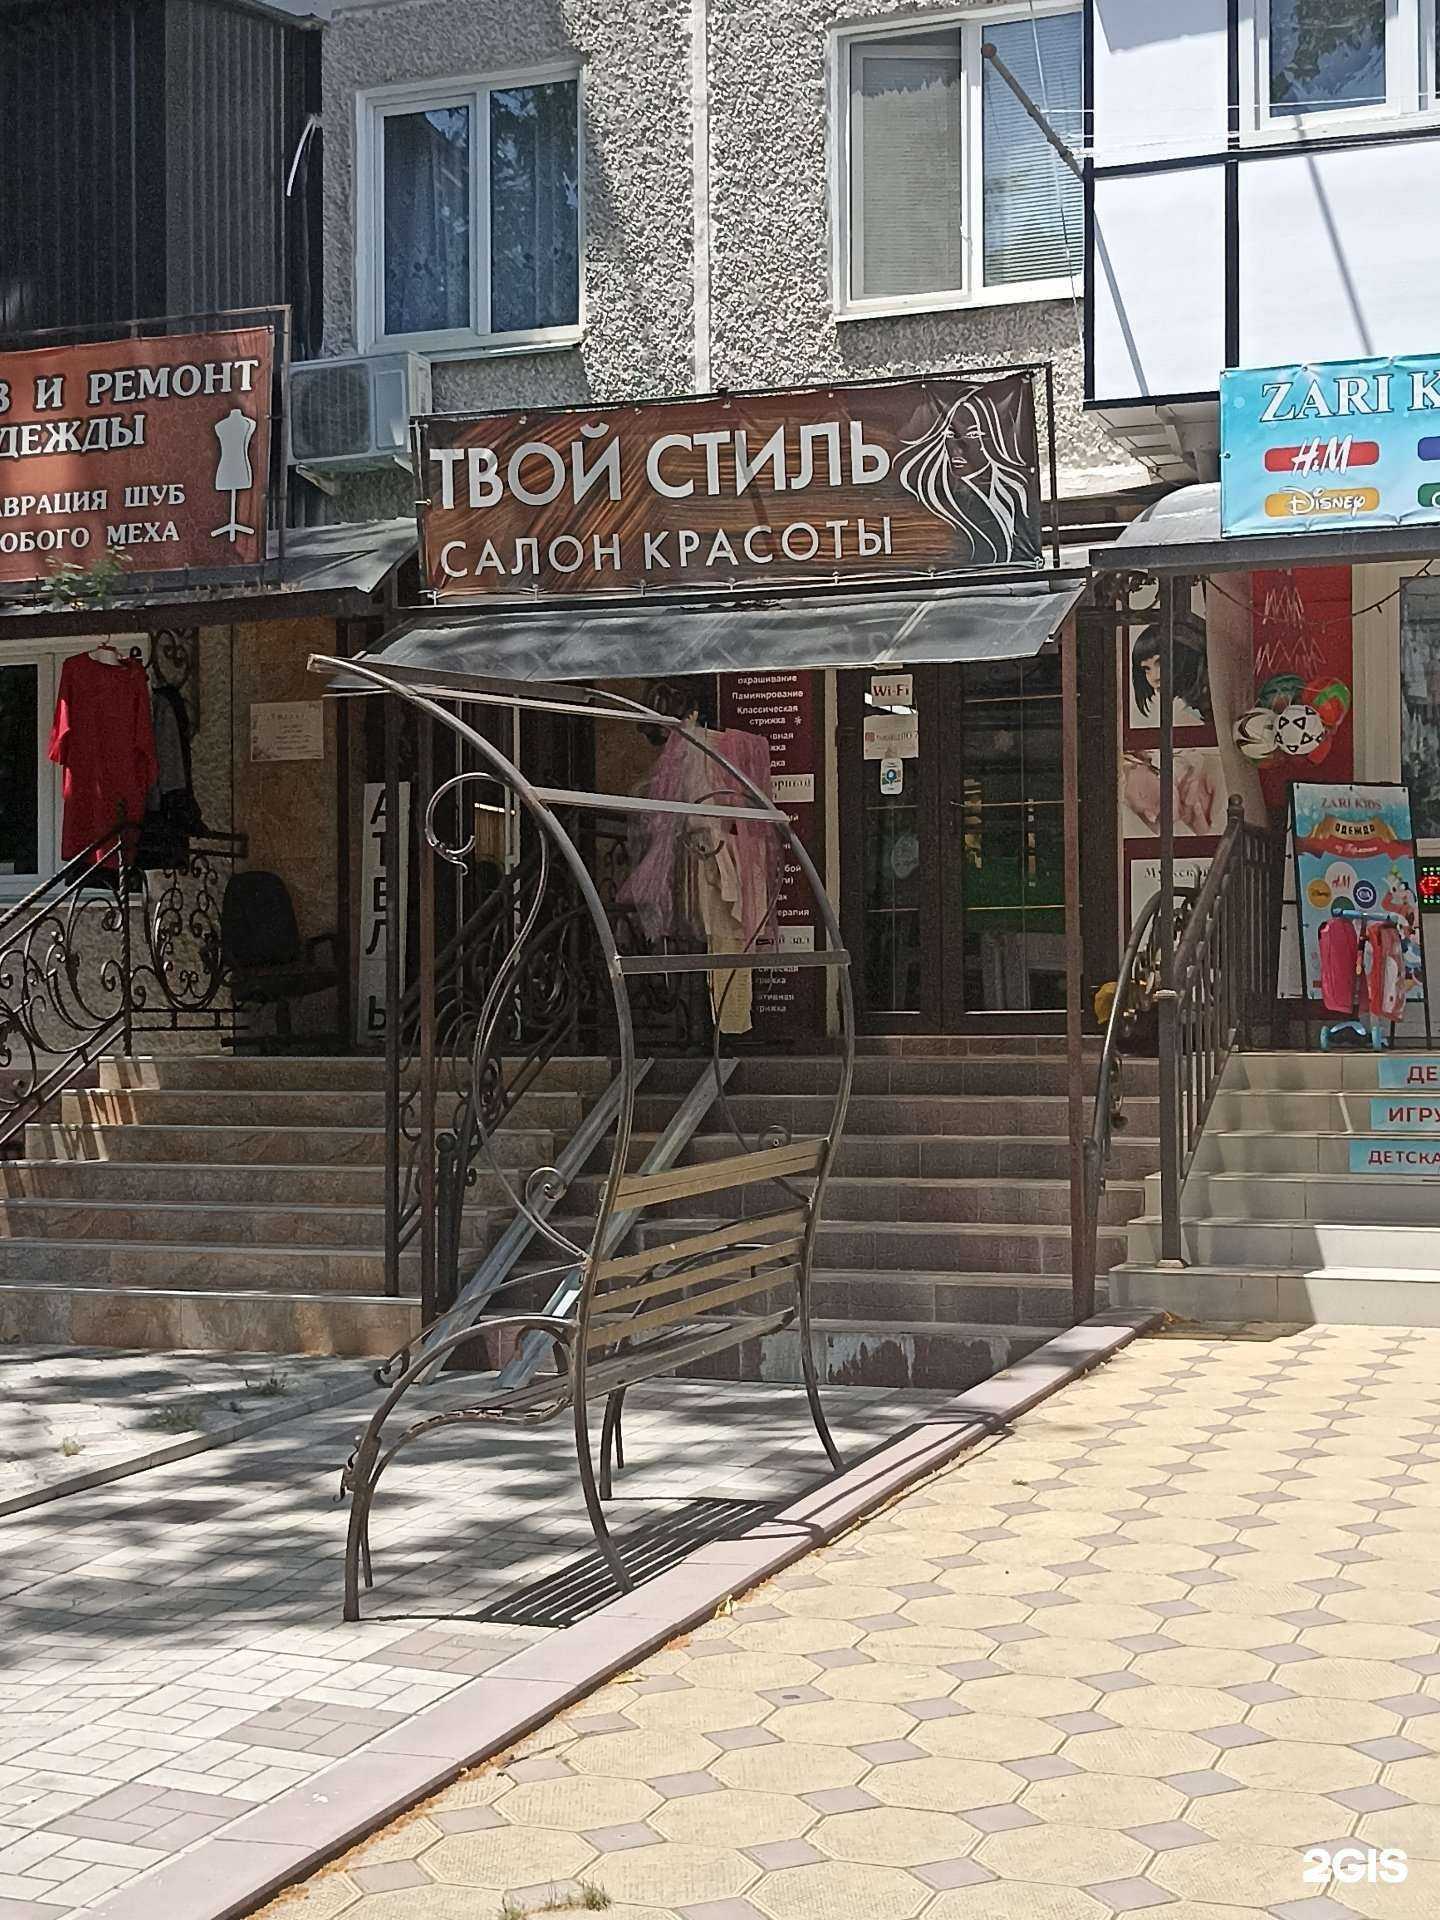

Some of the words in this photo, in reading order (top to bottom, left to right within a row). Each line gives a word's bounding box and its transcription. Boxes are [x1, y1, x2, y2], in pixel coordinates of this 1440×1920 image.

[36, 376, 65, 410] И
[89, 359, 259, 405] РЕМОНТ
[1260, 374, 1394, 423] ZARI
[0, 414, 145, 457] ДЕЖДЫ
[429, 422, 622, 511] ТВОЙ
[646, 420, 892, 498] СТИЛЬ
[1290, 433, 1353, 479] H&M
[0, 489, 108, 519] ВРАЦИЯ
[124, 483, 187, 509] ШУБ
[0, 527, 91, 554] ОБОГО
[106, 519, 181, 546] МЕХА
[440, 532, 622, 578] САЛОН
[644, 516, 893, 571] КРАСОТЫ
[736, 705, 798, 715] Классическая
[872, 684, 910, 698] Wi-Fi
[749, 717, 787, 727] стрижка
[1407, 1066, 1437, 1084] ДЕ
